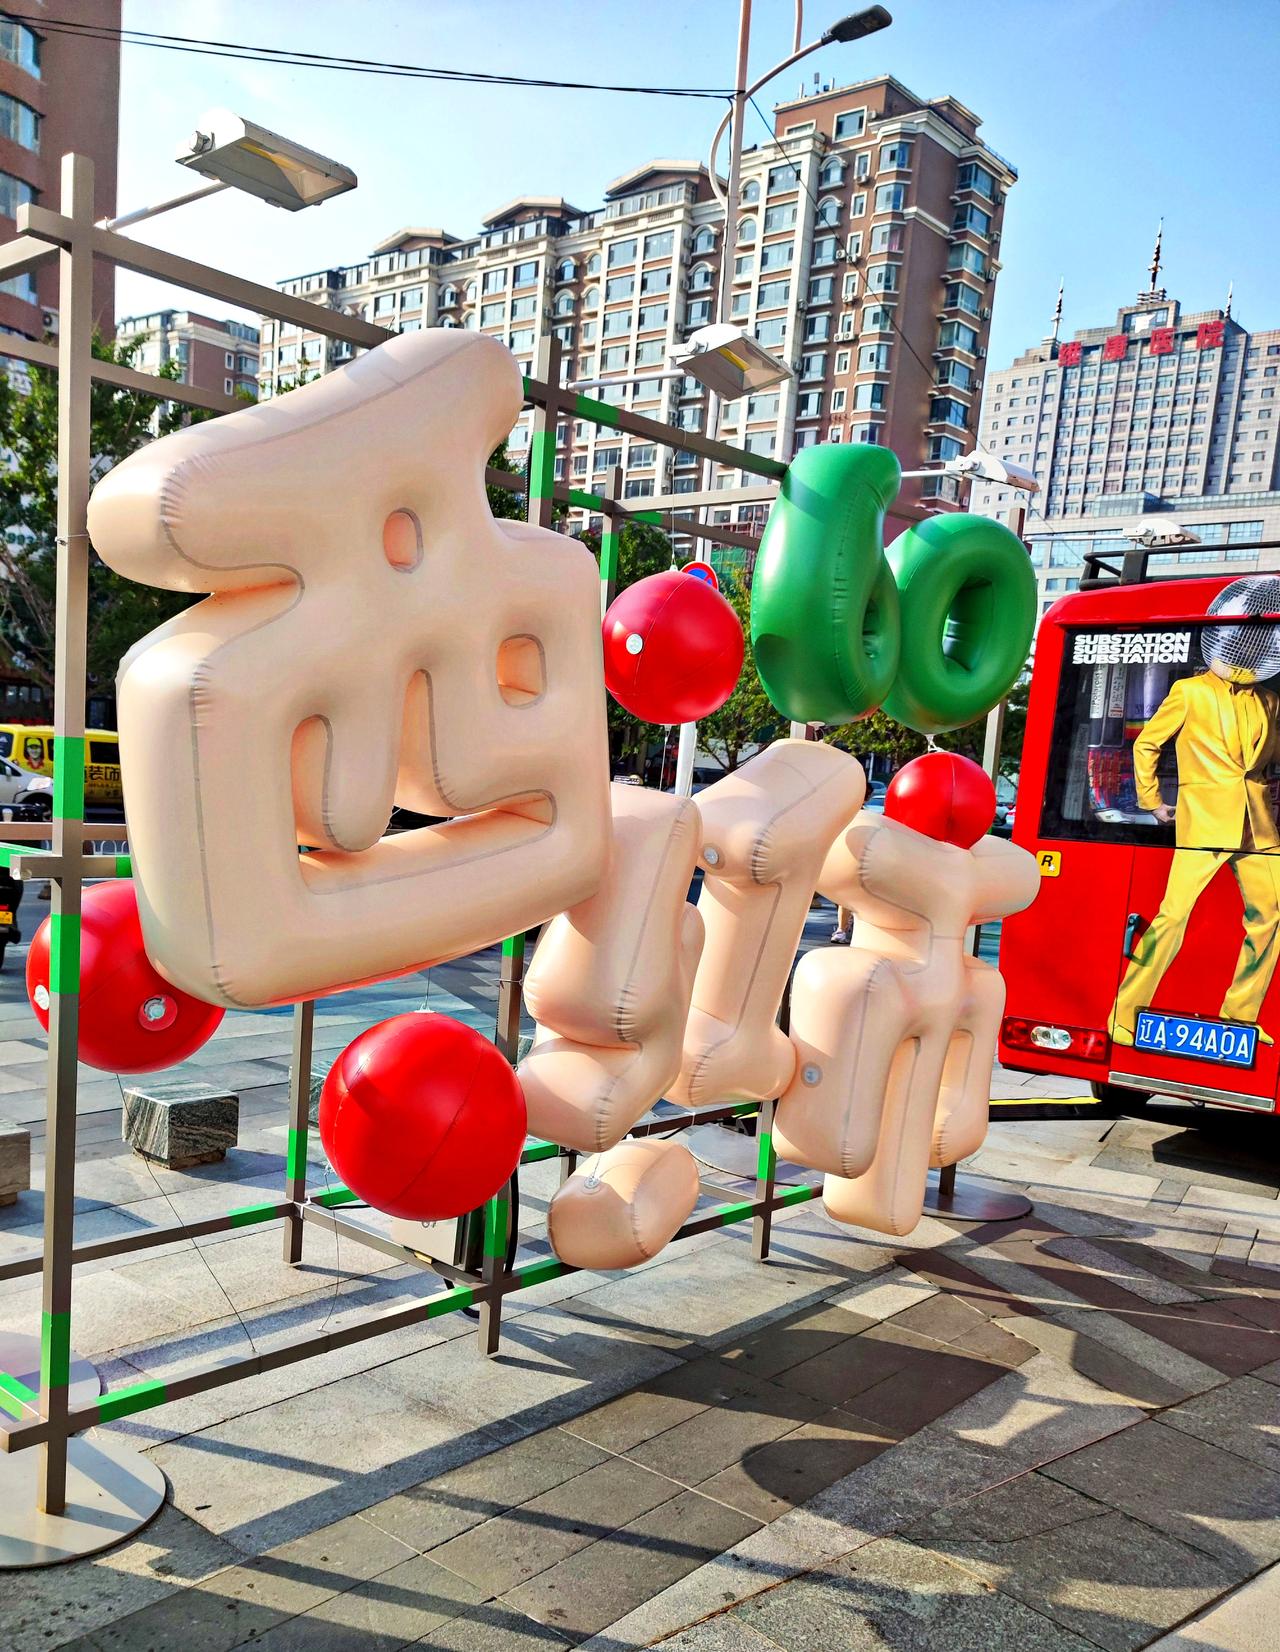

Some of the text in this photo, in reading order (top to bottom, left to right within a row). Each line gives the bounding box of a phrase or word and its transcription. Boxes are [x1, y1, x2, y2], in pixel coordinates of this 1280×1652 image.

[1074, 632, 1192, 646] SUBSTATION
[1073, 642, 1190, 655] SUBSTATION
[1071, 652, 1188, 665] SUBSTATION
